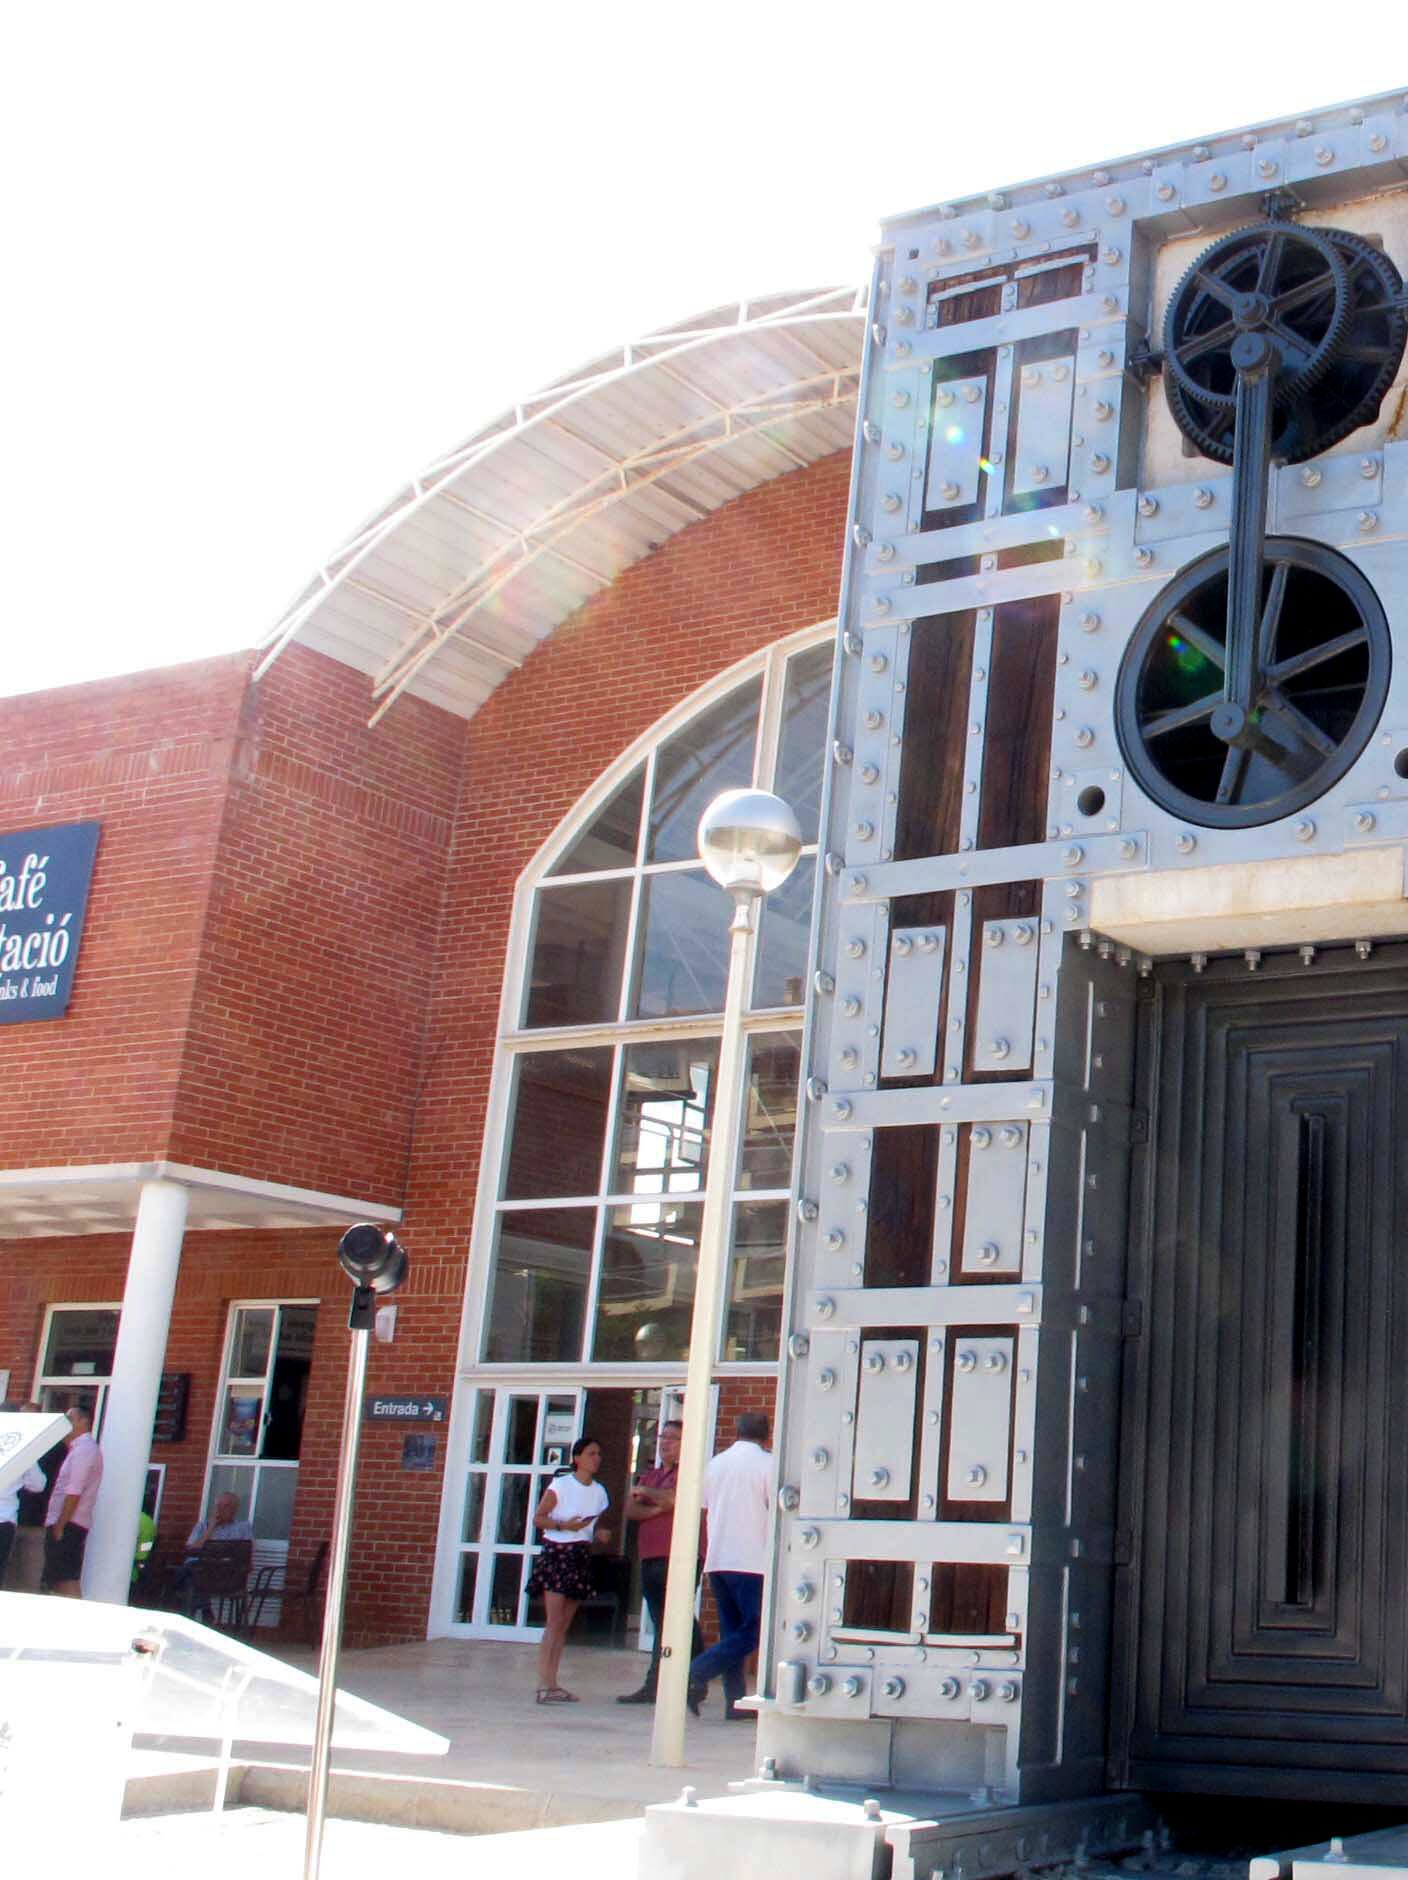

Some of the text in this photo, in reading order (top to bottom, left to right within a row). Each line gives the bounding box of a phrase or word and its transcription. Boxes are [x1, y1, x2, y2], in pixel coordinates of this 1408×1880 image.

[0, 853, 50, 913] afé
[31, 974, 58, 997] food
[374, 1401, 418, 1416] Entrada
